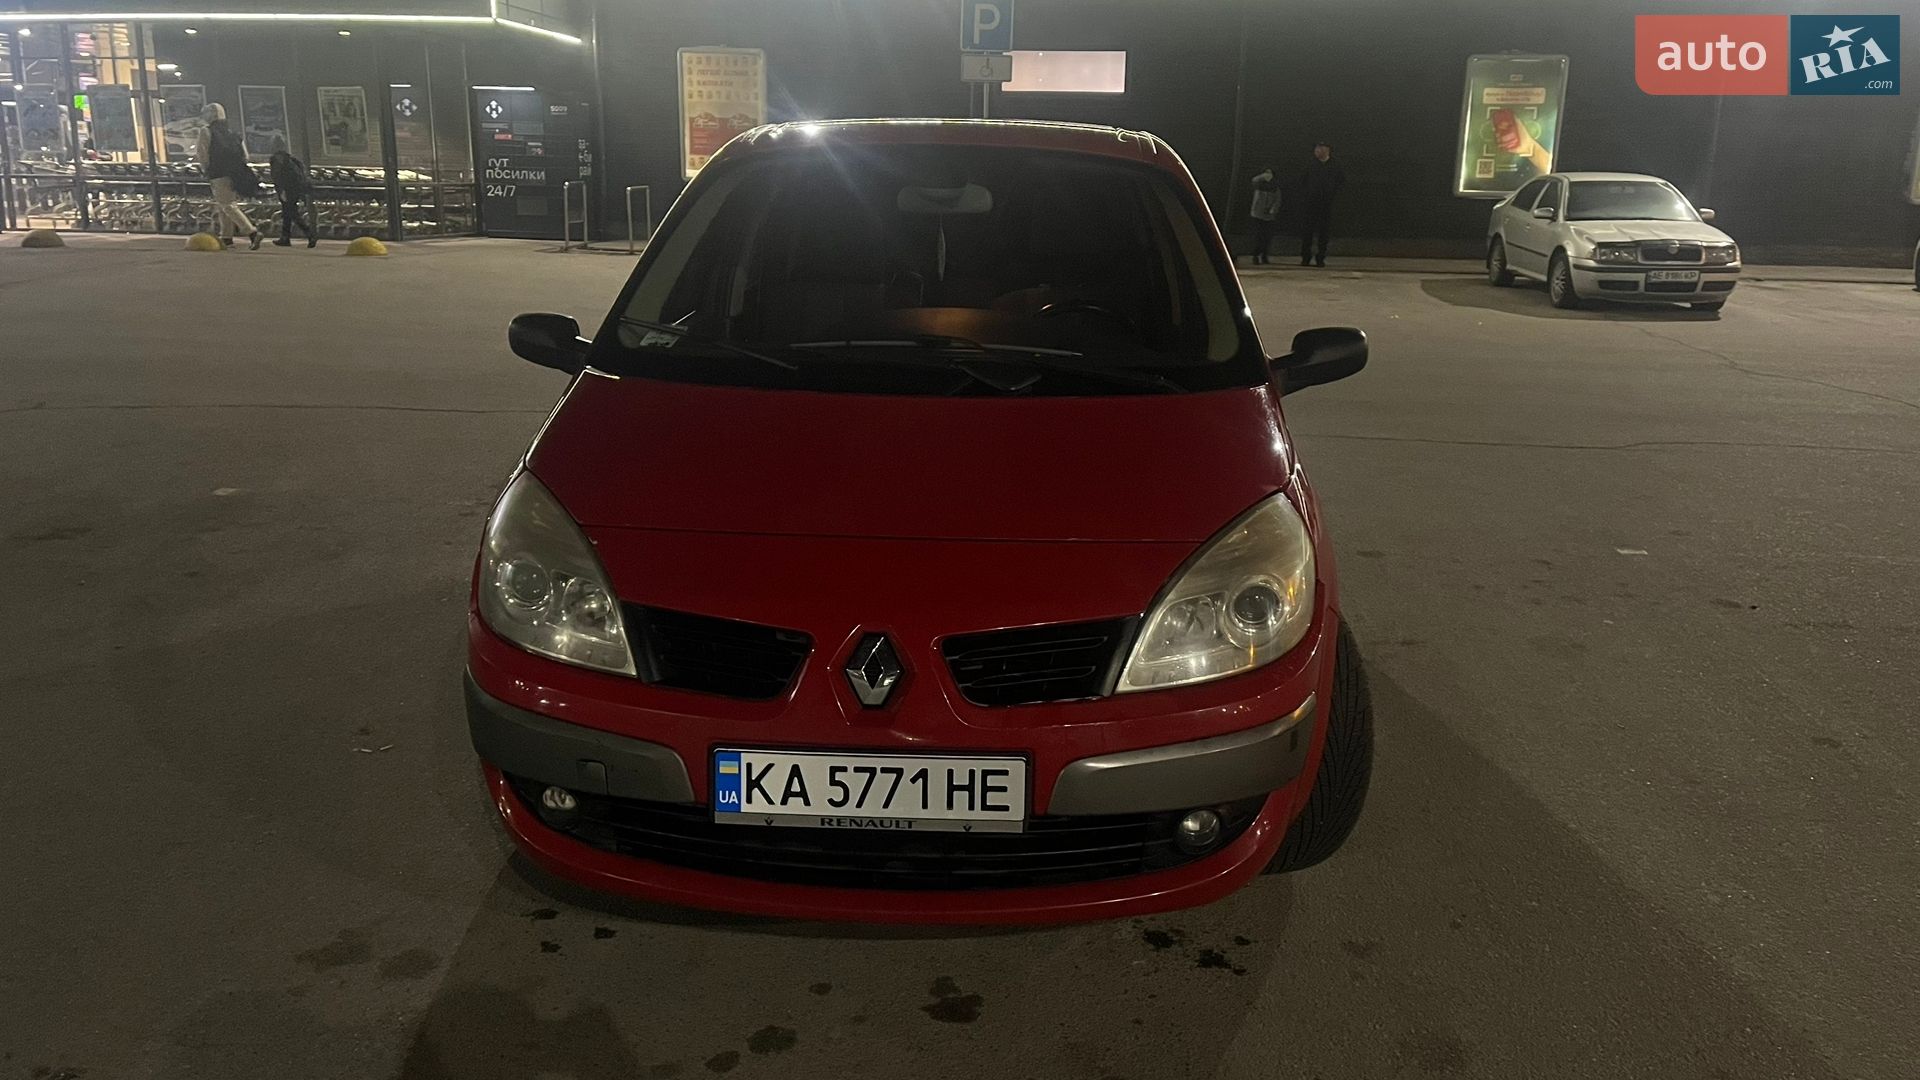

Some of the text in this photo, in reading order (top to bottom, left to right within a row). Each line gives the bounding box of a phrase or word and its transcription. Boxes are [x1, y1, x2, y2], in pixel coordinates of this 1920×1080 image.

[973, 3, 1001, 45] P
[486, 168, 545, 180] посилки
[486, 184, 516, 197] 24/7
[745, 762, 1010, 812] KA 5771 HE
[719, 790, 739, 804] UA
[820, 817, 917, 829] RENAULT
